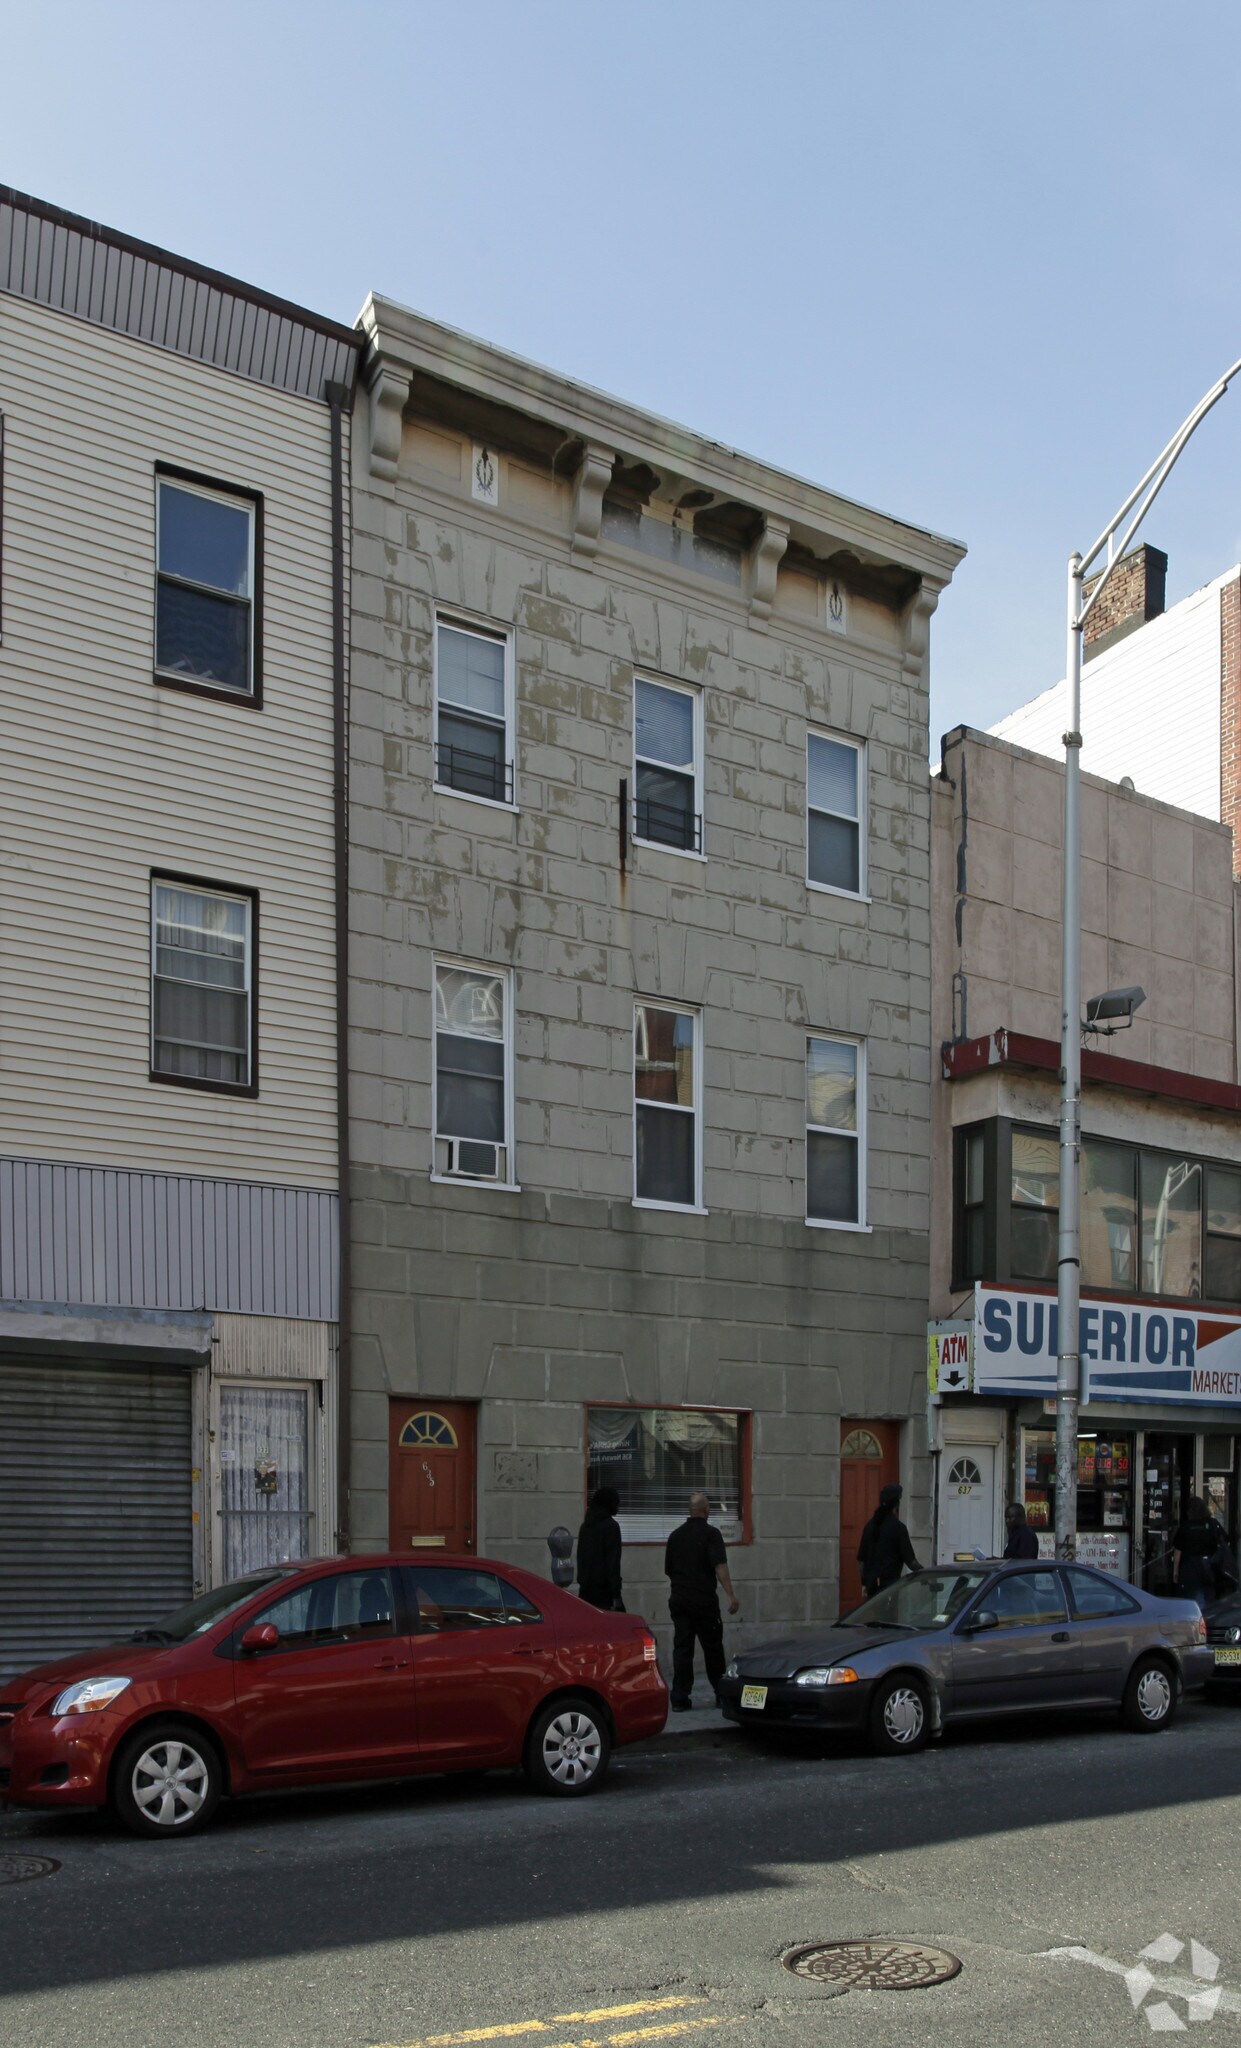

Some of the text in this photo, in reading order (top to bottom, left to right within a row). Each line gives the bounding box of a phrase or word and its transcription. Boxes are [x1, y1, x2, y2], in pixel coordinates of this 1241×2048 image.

[941, 1335, 968, 1365] ATM
[1192, 1370, 1241, 1395] MARKET
[422, 1461, 435, 1487] 635
[958, 1486, 972, 1495] 637
